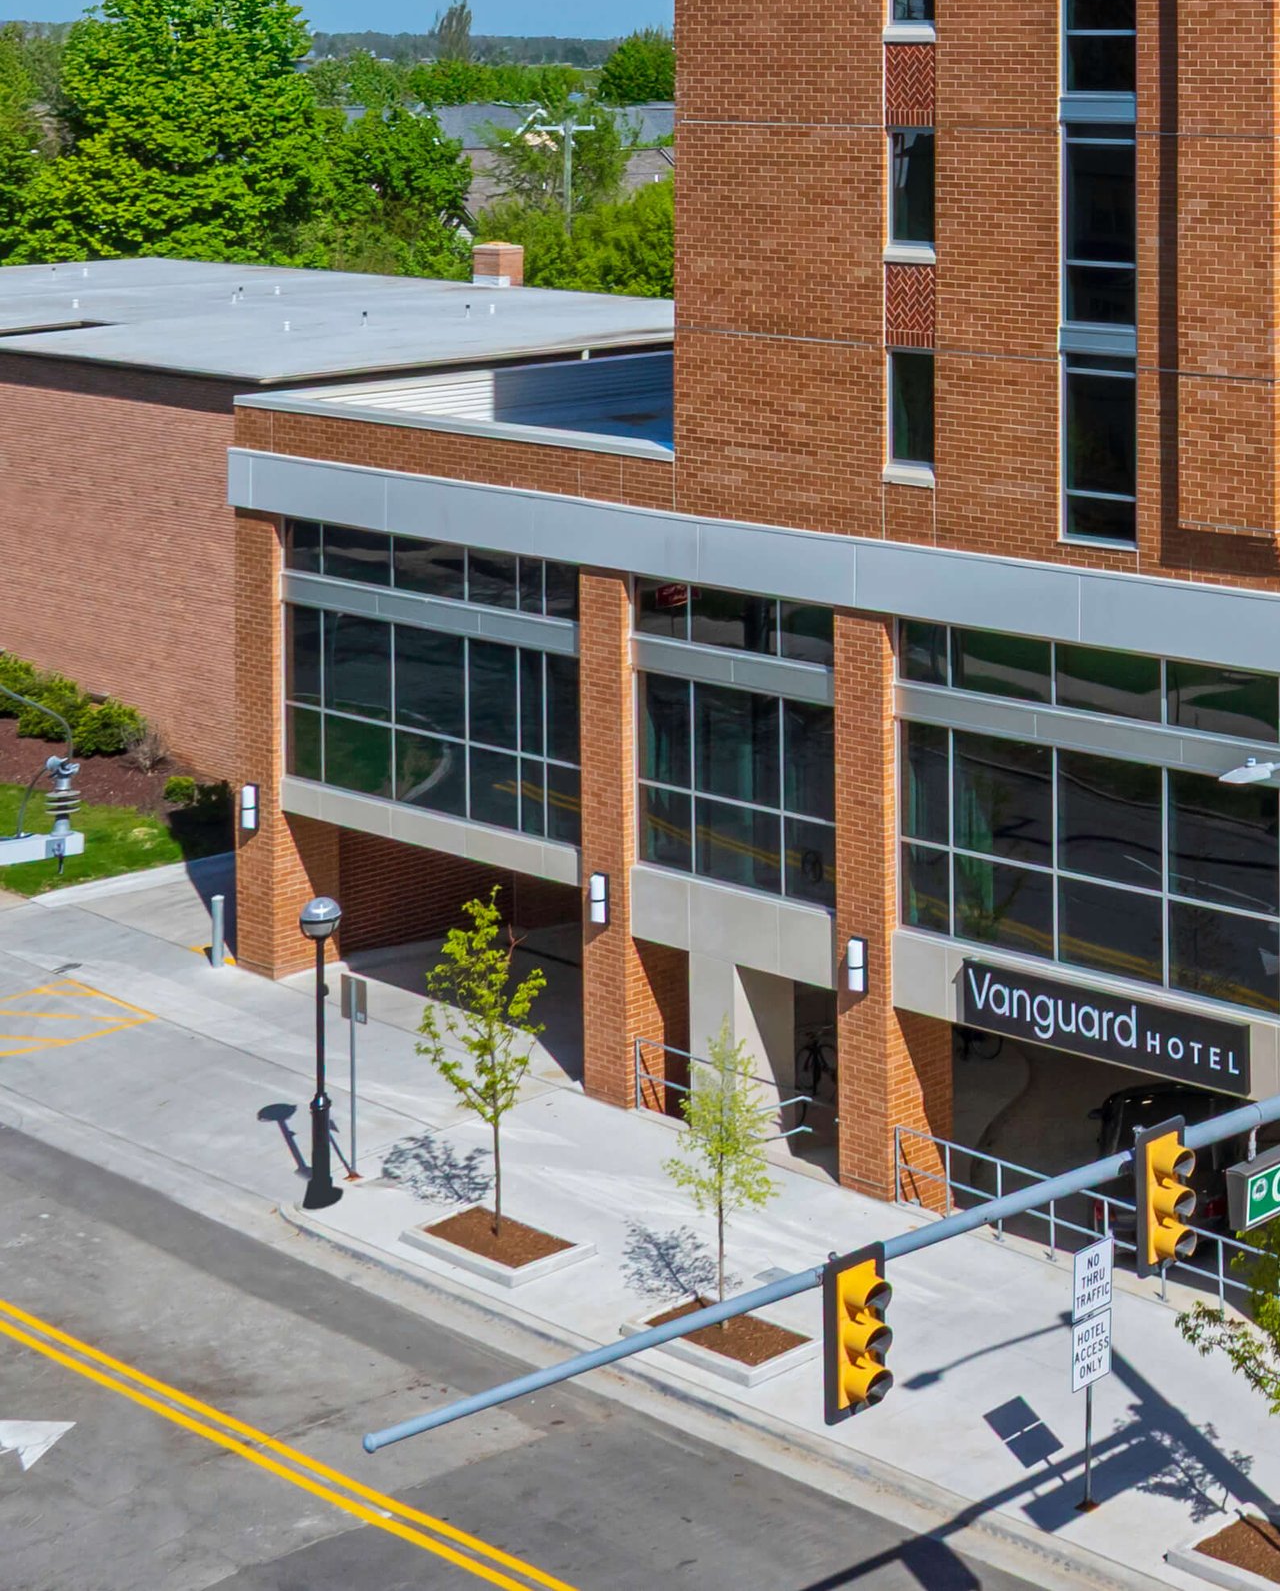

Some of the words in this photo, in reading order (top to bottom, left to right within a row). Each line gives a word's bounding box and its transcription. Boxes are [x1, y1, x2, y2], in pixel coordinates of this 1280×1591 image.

[968, 968, 1137, 1049] Vanguard
[1146, 1030, 1240, 1075] HOTEL
[1087, 1253, 1100, 1270] NO
[1081, 1267, 1106, 1290] THRU
[1076, 1281, 1110, 1310] TRAFFIC
[1077, 1322, 1106, 1347] HOTEL
[1074, 1335, 1109, 1365] ACCESS
[1079, 1355, 1103, 1379] ONLY
